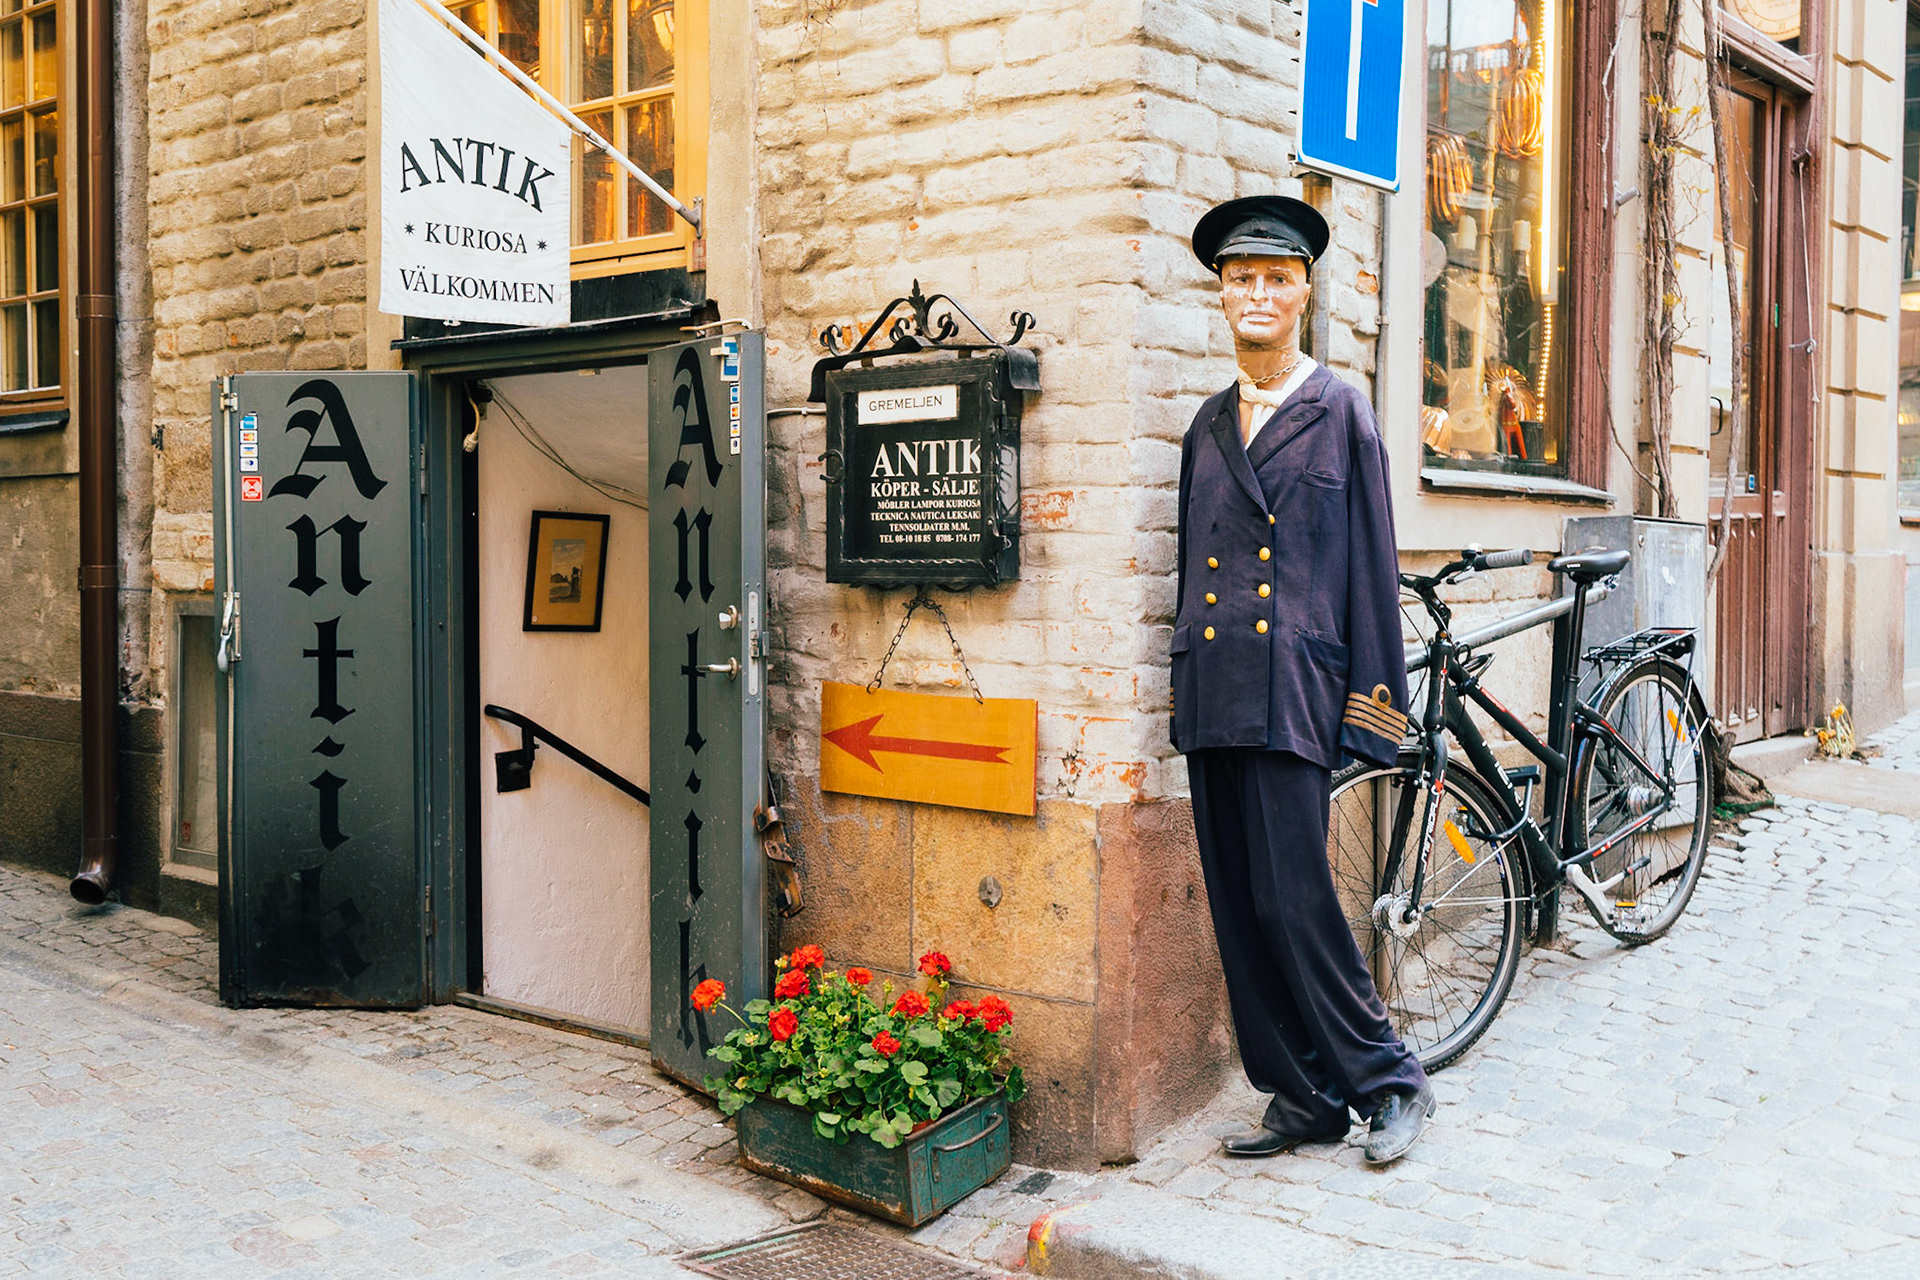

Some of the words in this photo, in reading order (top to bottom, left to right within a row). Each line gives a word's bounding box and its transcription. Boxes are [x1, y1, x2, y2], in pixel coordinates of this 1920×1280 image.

[400, 137, 555, 213] ANTIK
[425, 222, 528, 254] KURIOSA
[399, 264, 555, 304] VÄLKOMMEN
[868, 395, 943, 411] GREMELJEN
[871, 438, 982, 477] ANTIK
[871, 479, 921, 497] KÖPER
[932, 476, 981, 496] SÄLJE
[877, 499, 910, 510] MÖBLER
[911, 501, 945, 509] LAMPOR
[870, 512, 909, 521] TECKNICA
[910, 511, 945, 521] NAUTICA
[889, 523, 950, 532] TENNSOLDATER
[951, 522, 971, 531] M.M.
[879, 535, 894, 543] TEL
[266, 379, 389, 980] Antik
